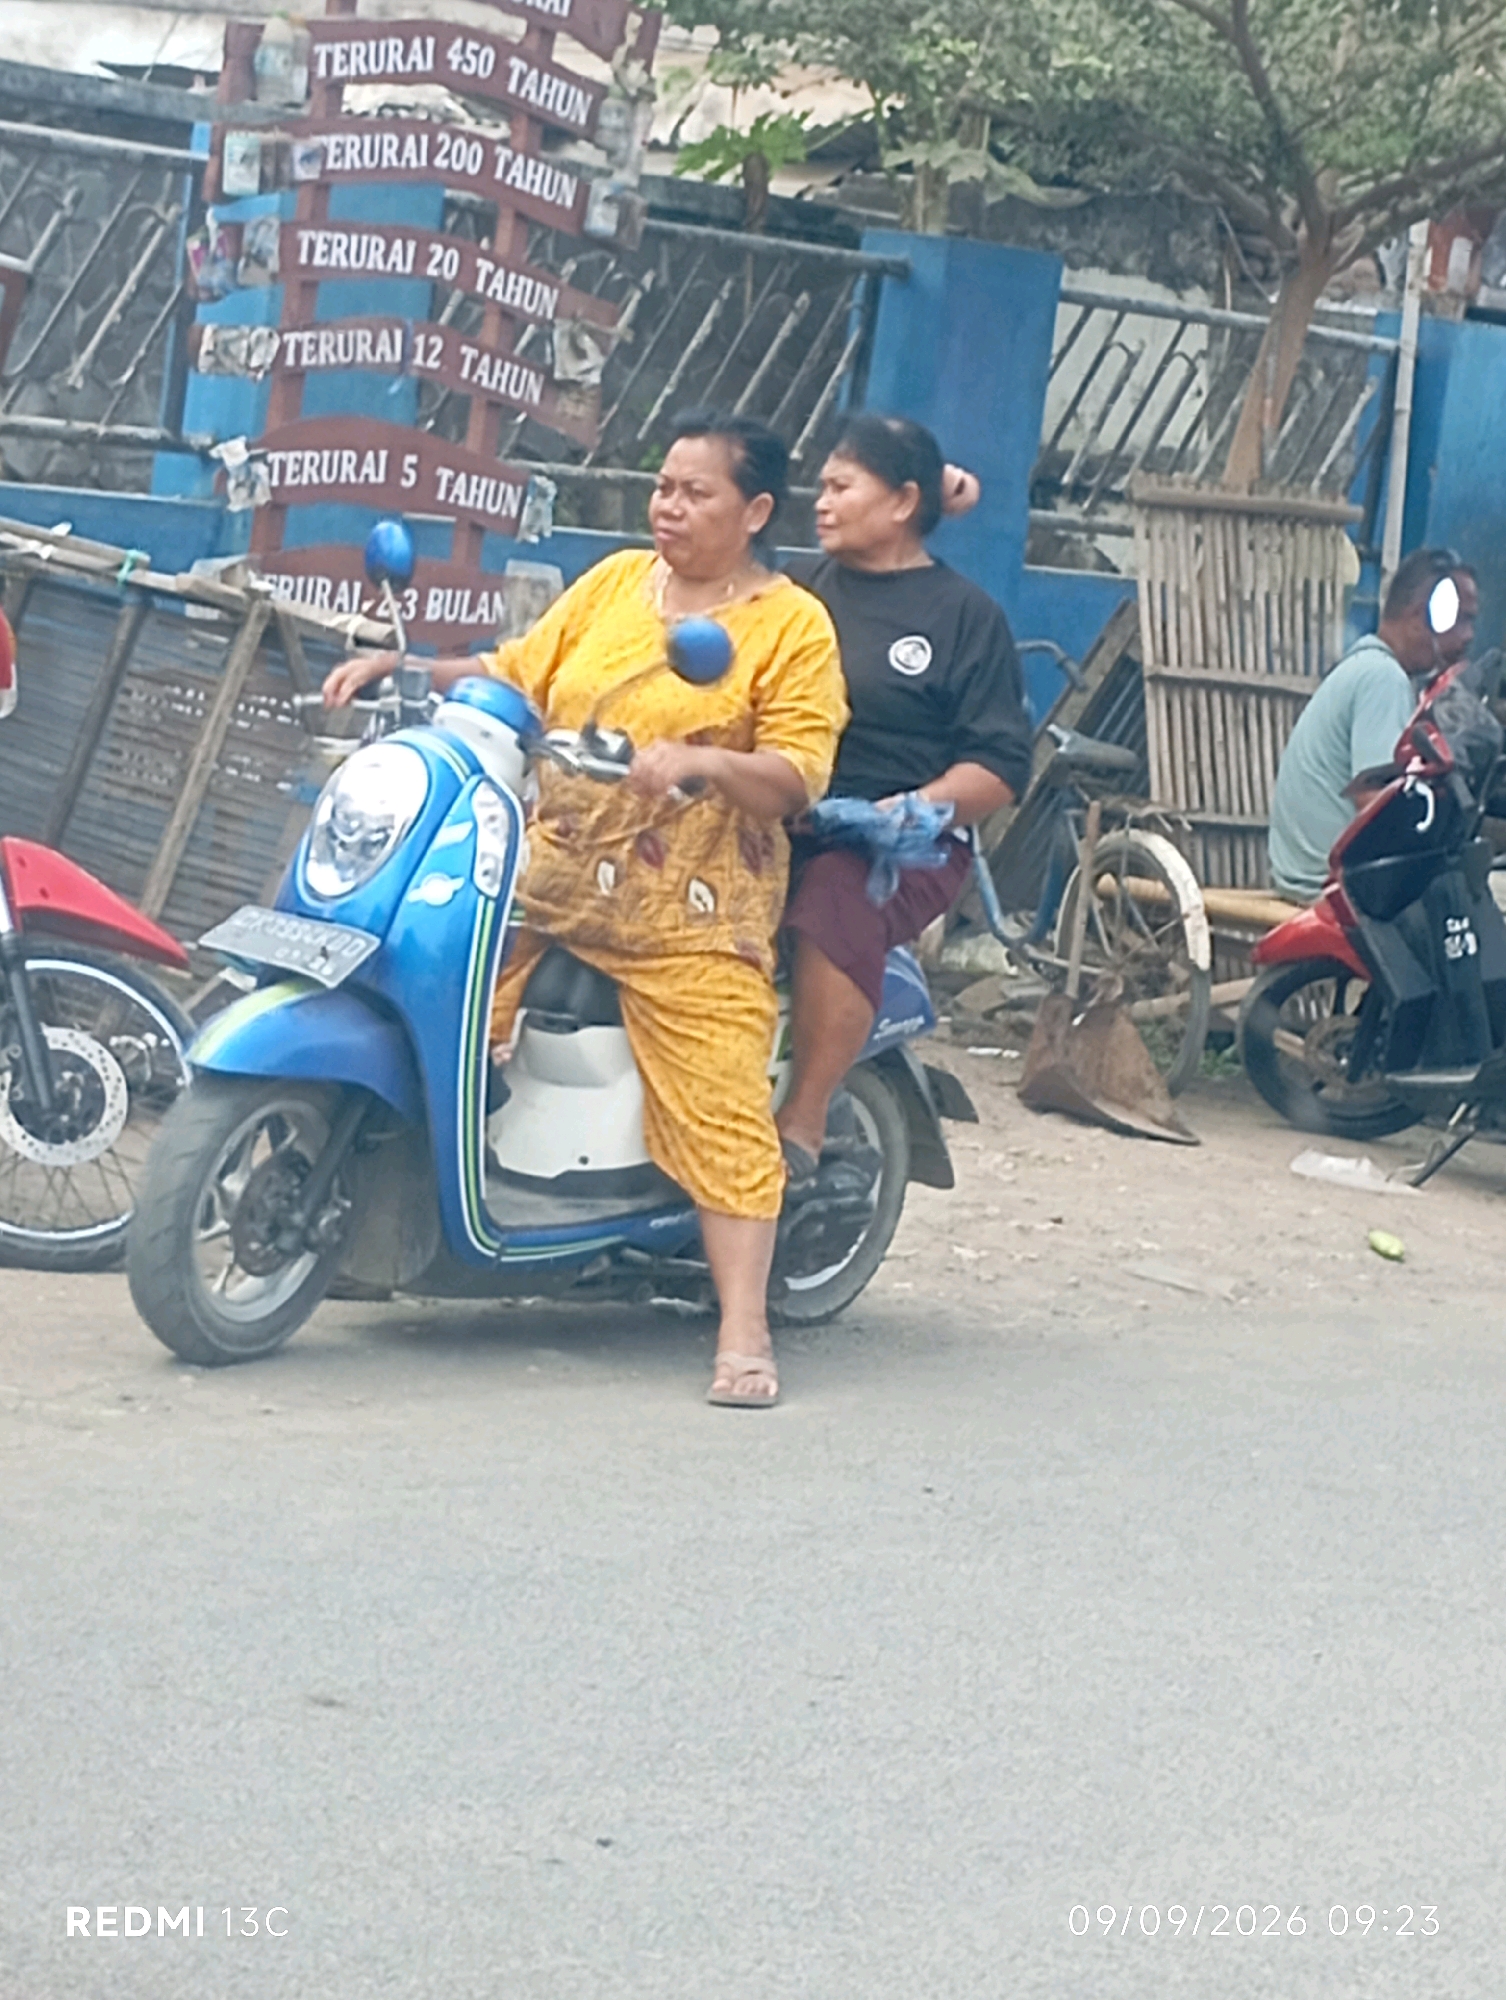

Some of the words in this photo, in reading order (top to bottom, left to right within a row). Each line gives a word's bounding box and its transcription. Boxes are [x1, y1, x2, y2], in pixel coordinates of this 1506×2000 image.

[314, 37, 435, 79] TERURAI
[446, 37, 495, 80] 450
[508, 57, 593, 126] TAHUN
[433, 132, 483, 176] 200
[494, 146, 578, 210] TAHUN
[297, 230, 416, 274] TERURAI
[426, 243, 460, 281] 20
[475, 258, 560, 320] TAHUN
[283, 329, 403, 368] TERURAI
[412, 334, 443, 368] 12
[460, 345, 544, 406] TAHUN
[267, 450, 388, 487] TERURAI
[401, 454, 418, 488] 5
[436, 467, 524, 519] TAHUN
[255, 574, 363, 615] ERURAI
